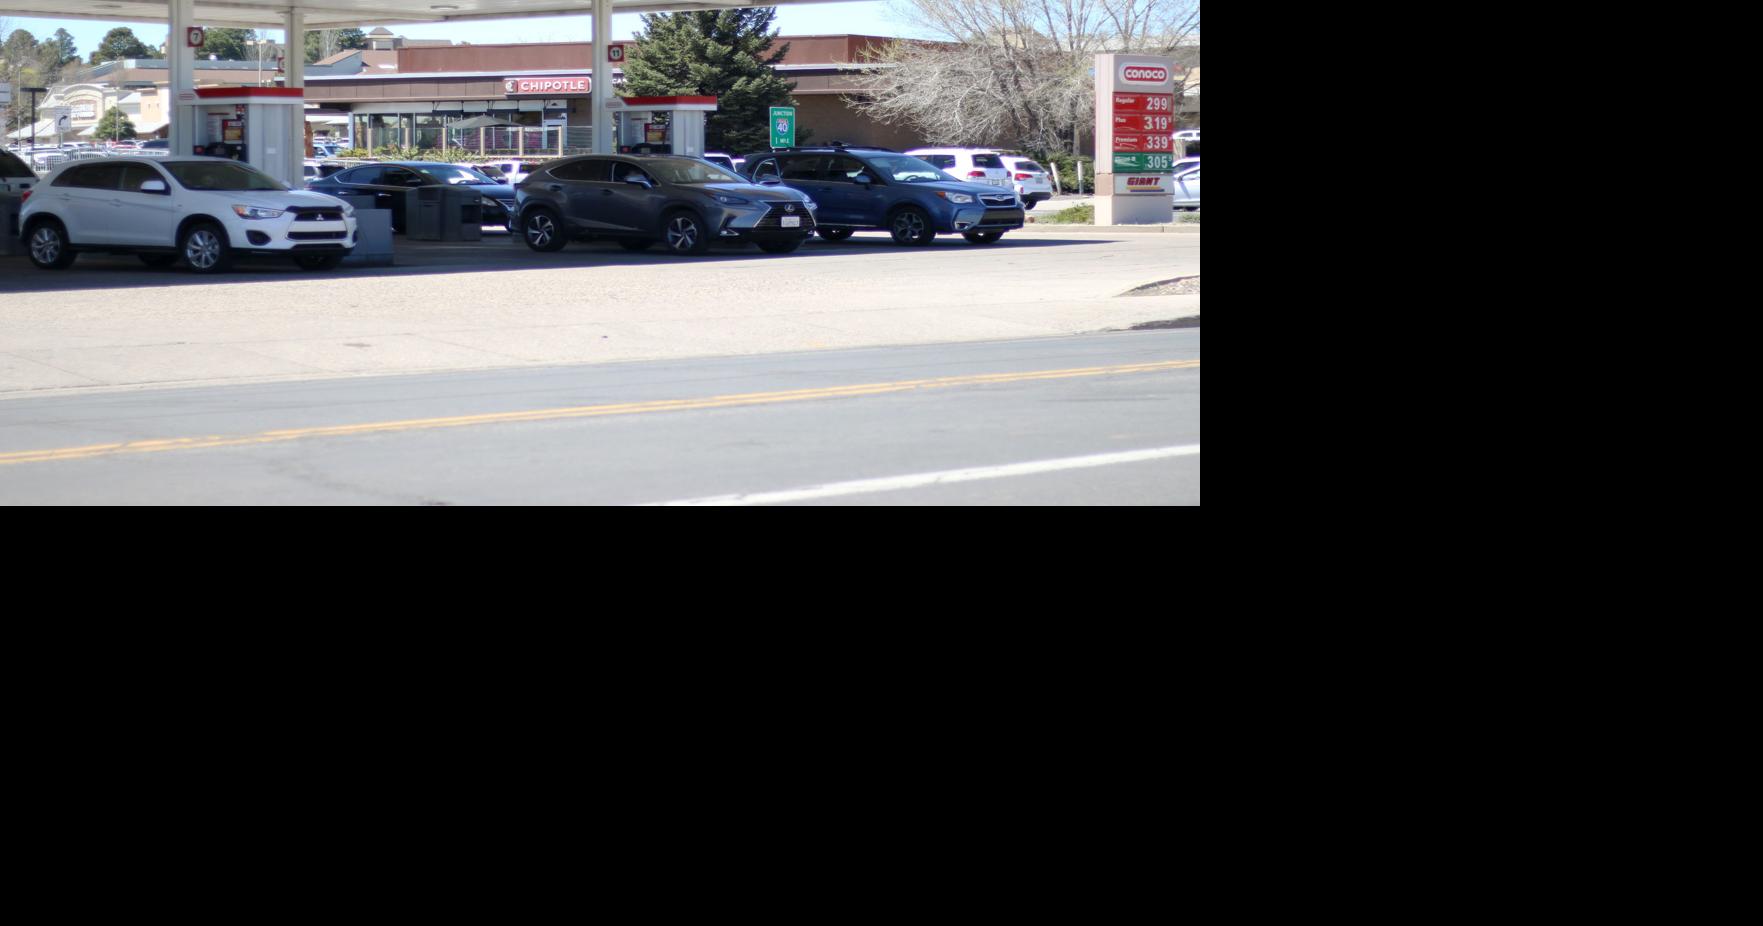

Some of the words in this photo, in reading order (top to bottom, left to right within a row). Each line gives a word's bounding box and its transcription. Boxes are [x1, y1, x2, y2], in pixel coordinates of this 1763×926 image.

[1125, 69, 1165, 79] conoco
[520, 81, 585, 90] CHIPOTLE
[1146, 96, 1167, 110] 299
[778, 123, 788, 132] 40
[1146, 135, 1168, 149] 339
[1147, 155, 1168, 168] 305
[1127, 177, 1160, 186] GIANT
